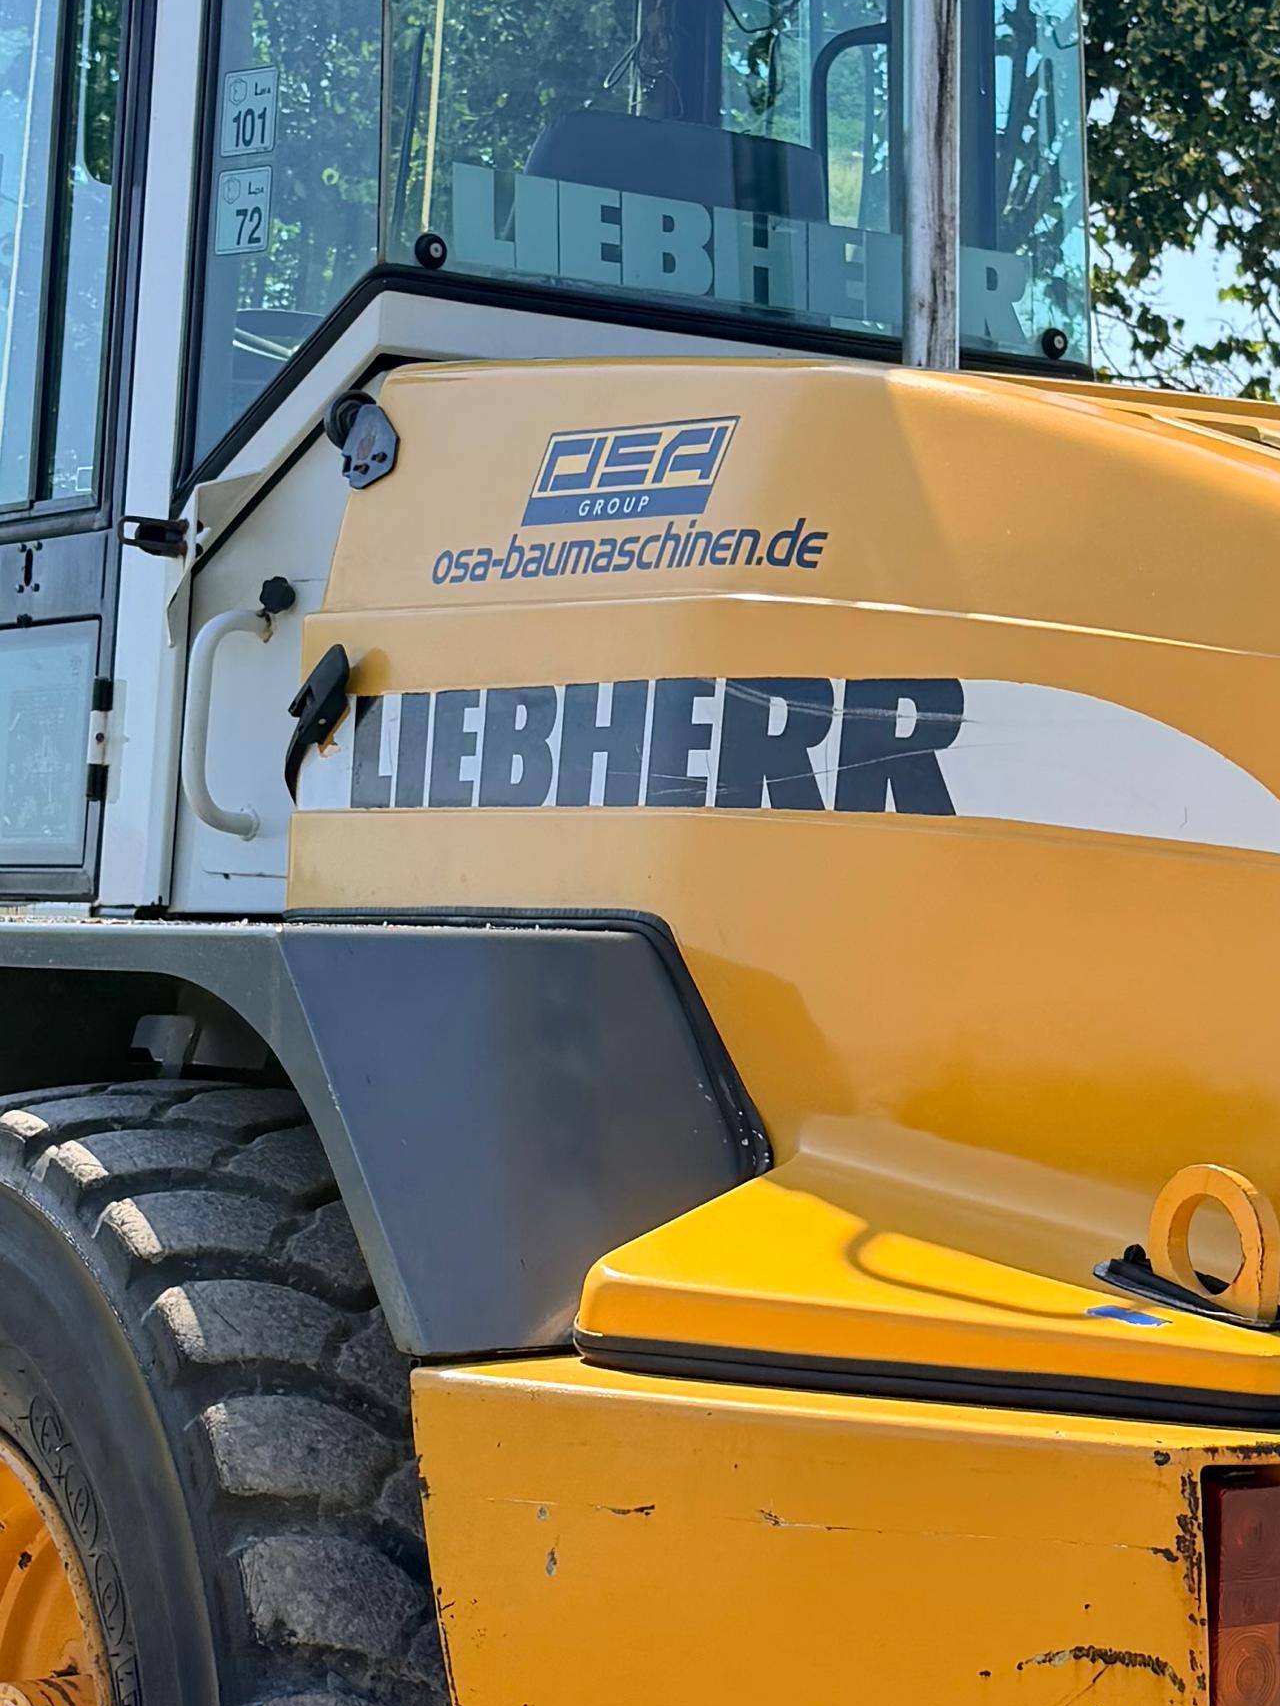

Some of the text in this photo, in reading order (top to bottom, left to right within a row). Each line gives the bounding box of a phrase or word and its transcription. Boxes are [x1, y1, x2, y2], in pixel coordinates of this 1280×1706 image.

[232, 106, 268, 148] 101
[235, 205, 263, 246] 72
[537, 424, 730, 493] OSA
[577, 494, 651, 518] GROUP
[431, 516, 830, 586] osa-baumaschinen.de
[349, 677, 966, 817] LIEBHERR
